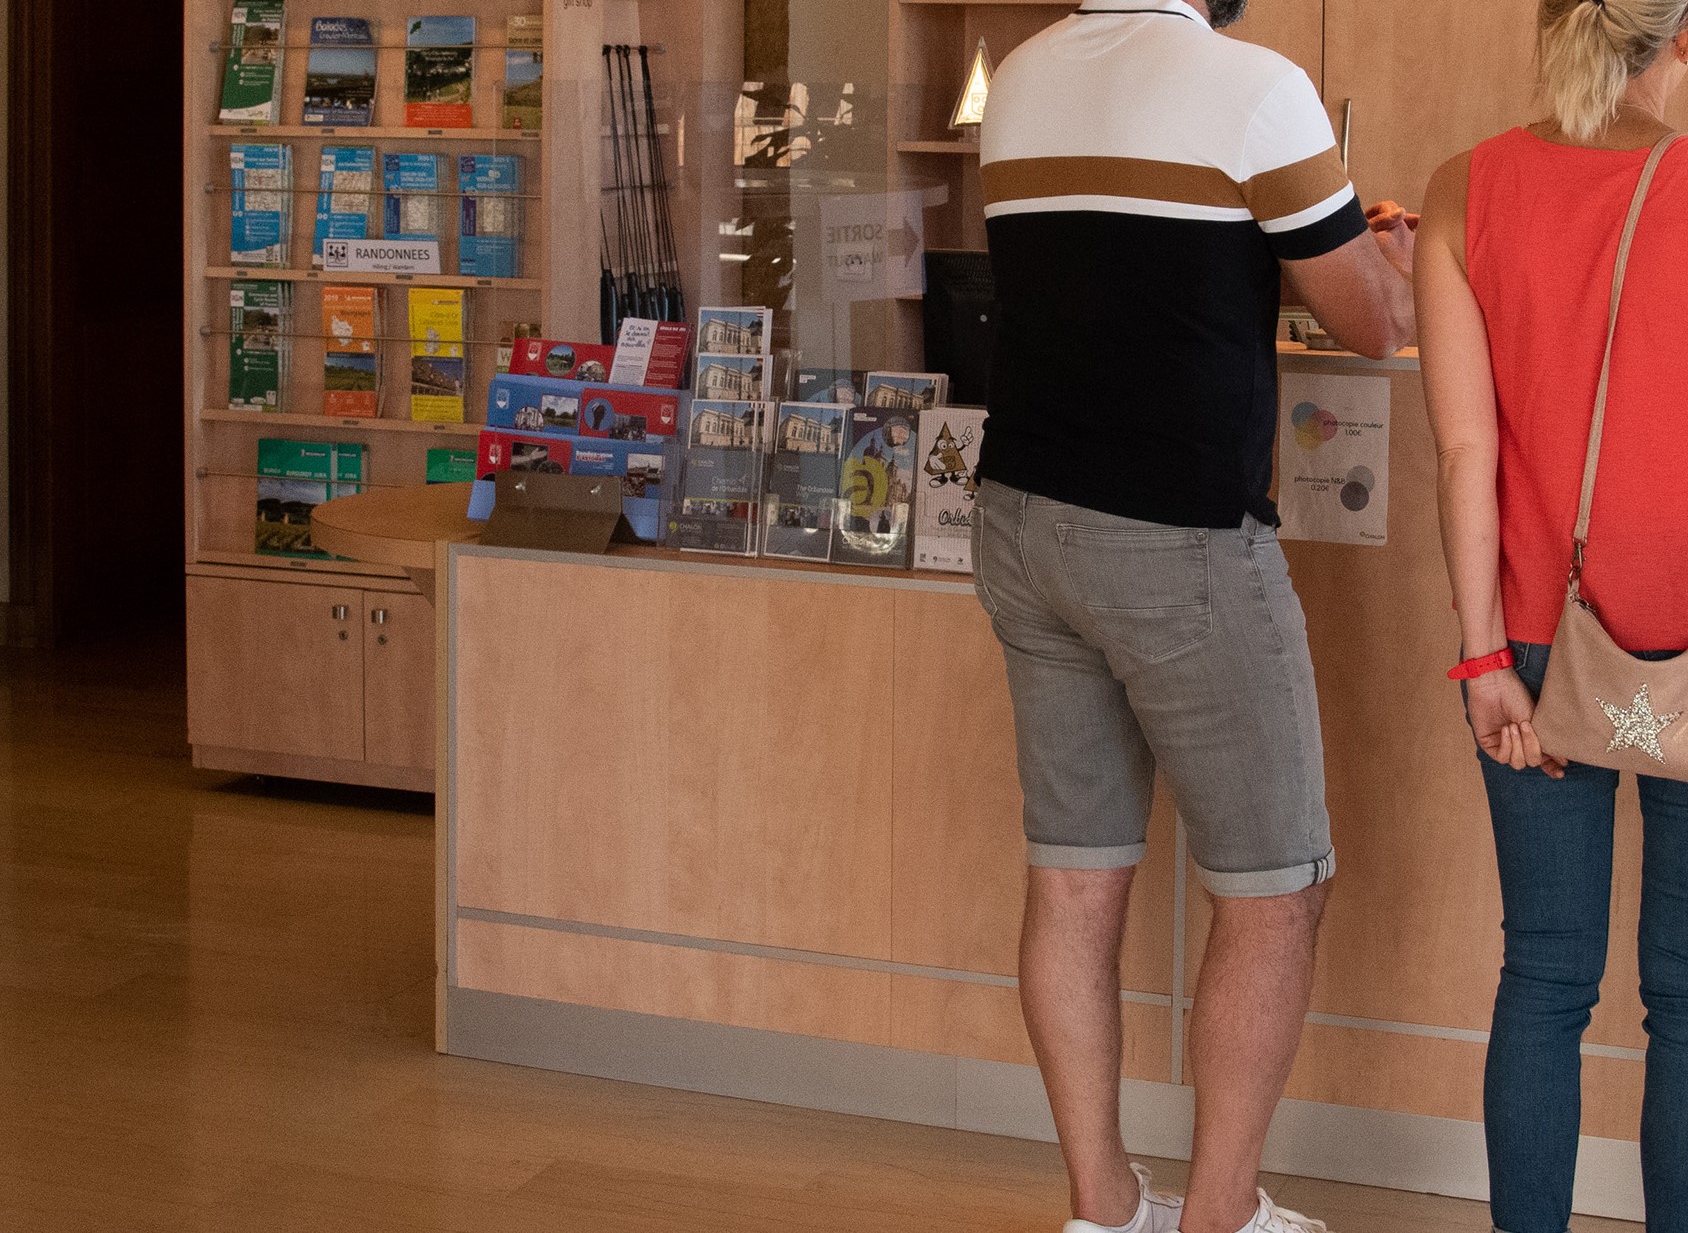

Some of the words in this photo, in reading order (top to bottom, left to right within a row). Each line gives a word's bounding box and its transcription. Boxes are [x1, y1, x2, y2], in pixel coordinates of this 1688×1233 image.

[355, 248, 430, 260] RANDONNEES
[1323, 419, 1359, 429] photocopie
[1360, 421, 1384, 429] couleur
[1294, 475, 1330, 485] photocopie
